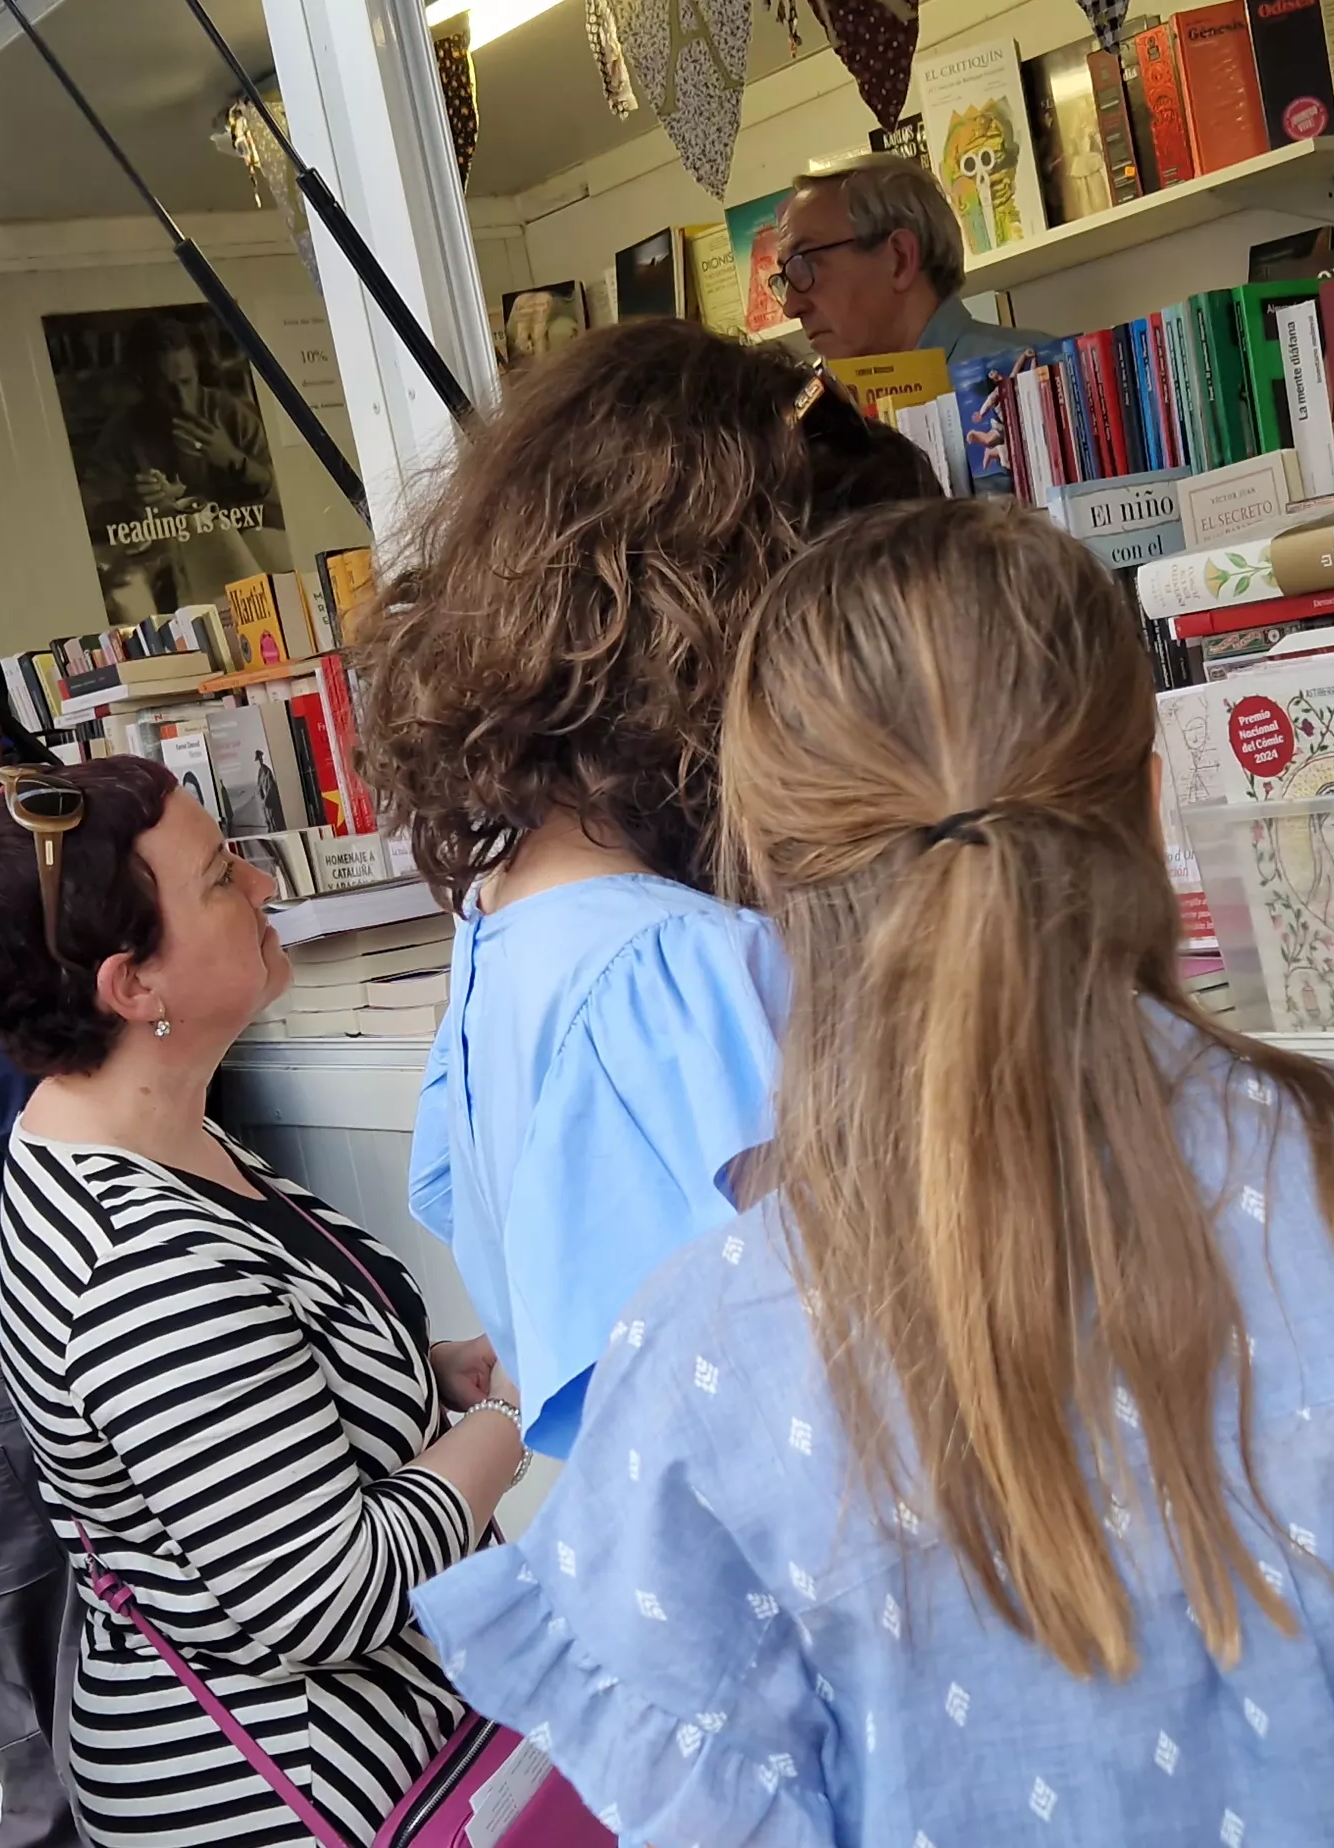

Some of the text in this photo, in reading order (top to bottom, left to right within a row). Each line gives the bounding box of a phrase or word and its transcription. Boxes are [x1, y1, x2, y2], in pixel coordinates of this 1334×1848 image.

[925, 70, 939, 82] EL
[940, 49, 1004, 78] CRITIQUÍN
[1287, 320, 1308, 421] La mente diáfana
[1091, 490, 1174, 529] El niño
[1201, 516, 1216, 532] EL
[1218, 500, 1273, 527] SECRETO
[106, 505, 192, 546] reading
[218, 503, 265, 532] sexy
[1112, 534, 1164, 563] con el
[1238, 708, 1271, 726] Premio
[1238, 720, 1279, 740] Nacional
[1241, 734, 1284, 753] del Cómic
[1254, 749, 1278, 764] 2024
[325, 851, 368, 867] HOMENAJE
[369, 851, 376, 862] A
[332, 863, 374, 880] CATALUÑA
